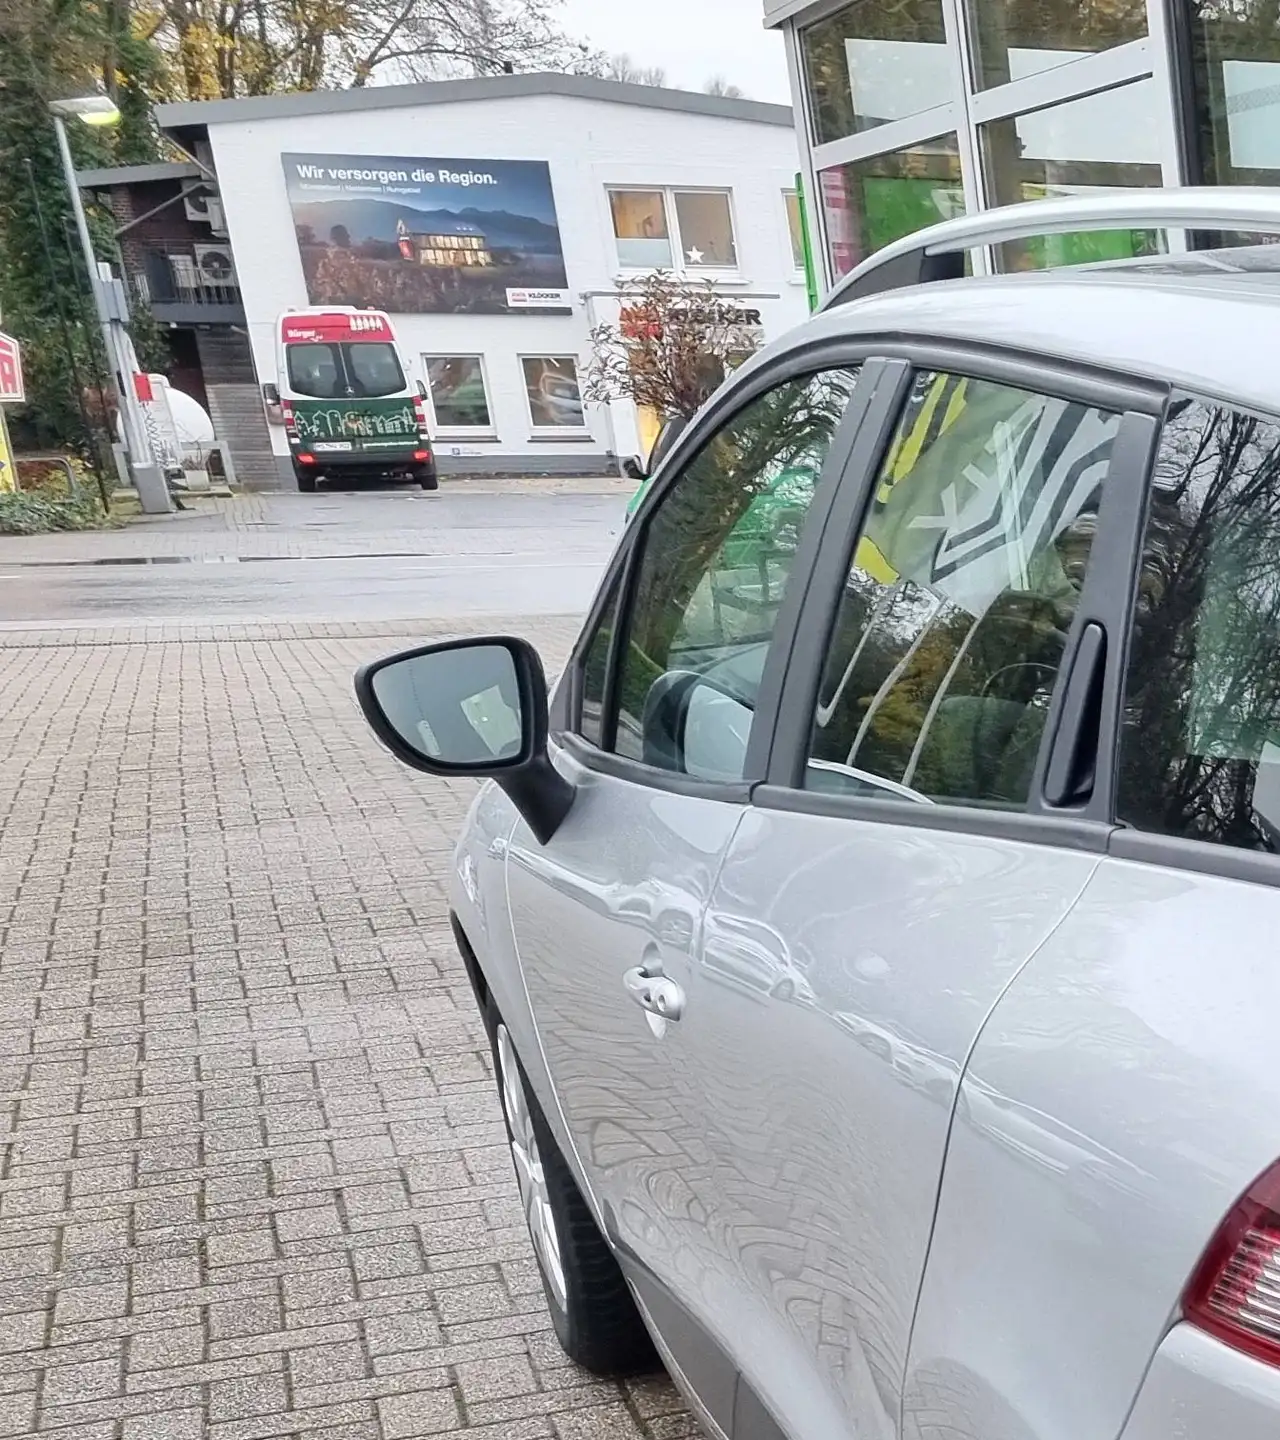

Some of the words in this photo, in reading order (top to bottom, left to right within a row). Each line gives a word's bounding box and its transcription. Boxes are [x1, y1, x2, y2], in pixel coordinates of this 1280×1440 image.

[296, 165, 325, 179] Wir
[328, 168, 408, 185] versorgen
[411, 168, 435, 183] die
[438, 169, 498, 187] Region.
